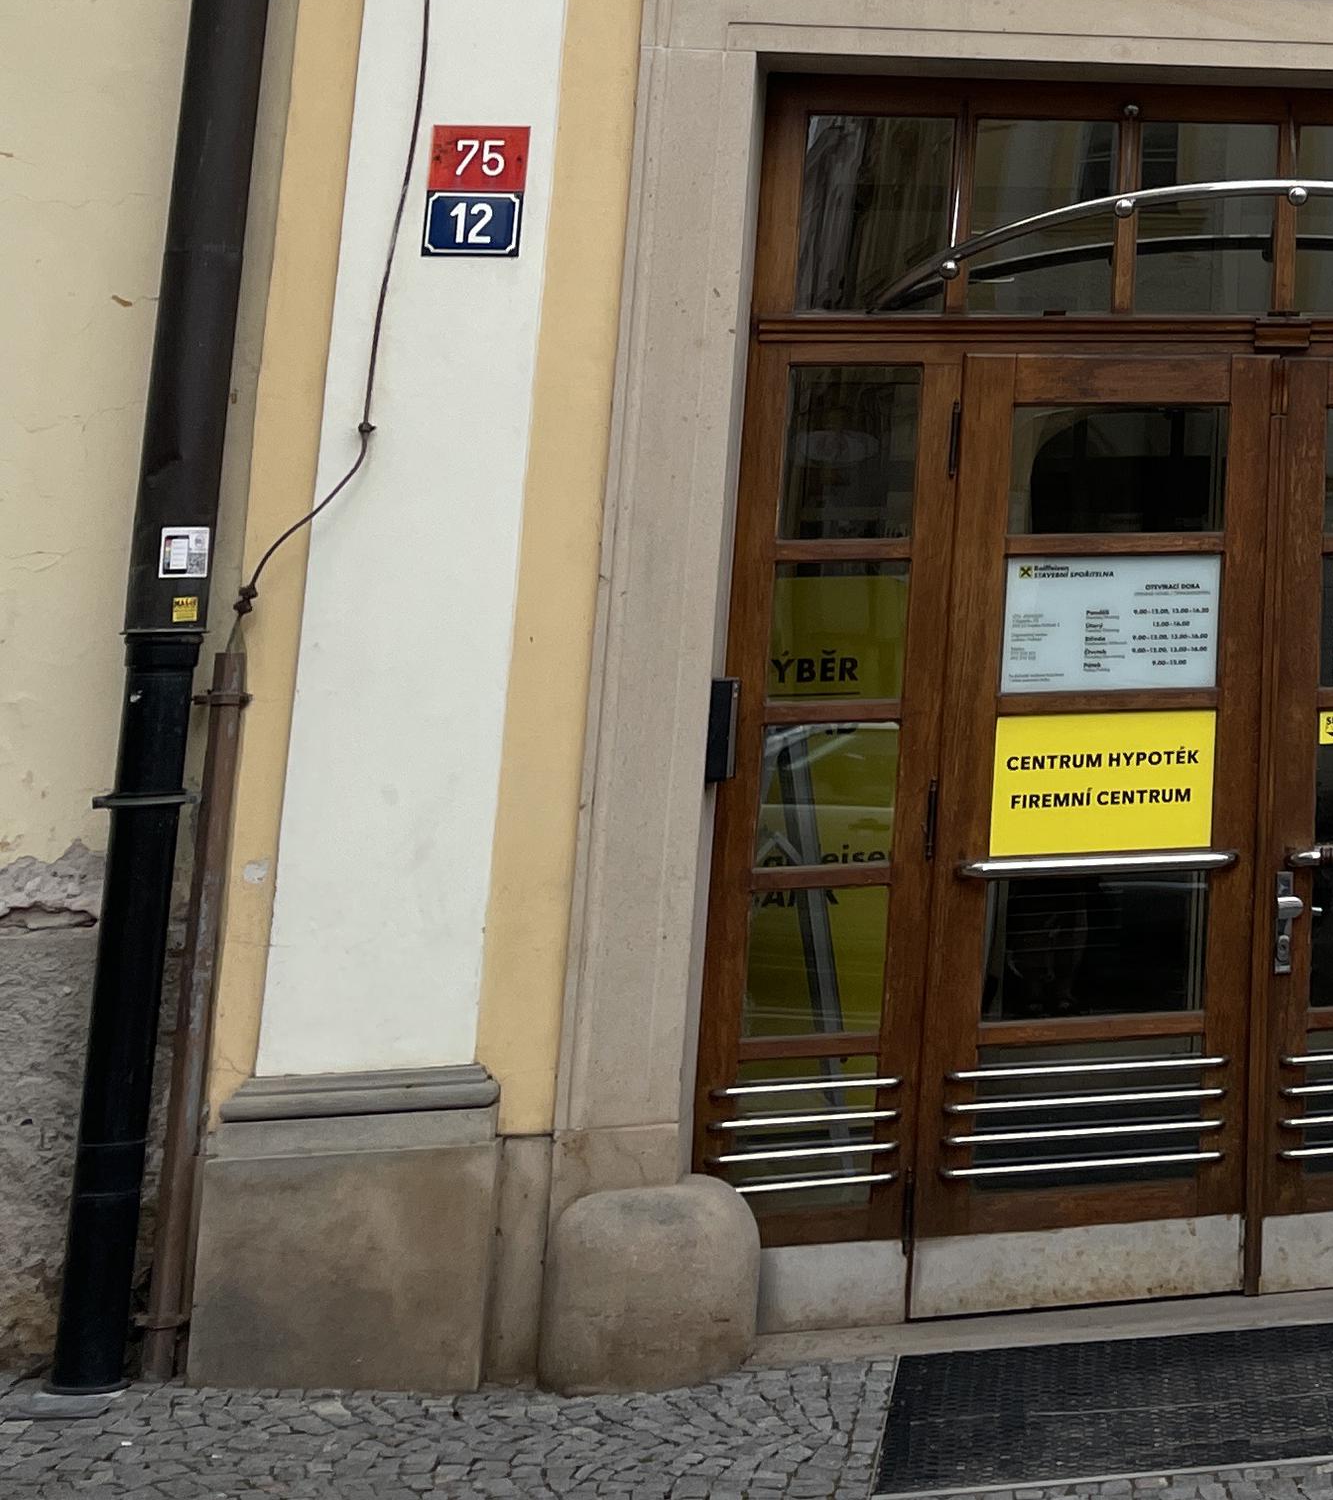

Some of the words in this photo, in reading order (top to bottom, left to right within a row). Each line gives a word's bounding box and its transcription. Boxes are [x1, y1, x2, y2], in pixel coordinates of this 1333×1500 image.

[455, 140, 505, 176] 75
[450, 202, 493, 244] 12
[1006, 752, 1102, 771] CENTRUM
[1108, 747, 1199, 768] HYPOTÉK
[1010, 787, 1092, 810] FIREMNÍ
[1096, 788, 1192, 806] CENTRUM
